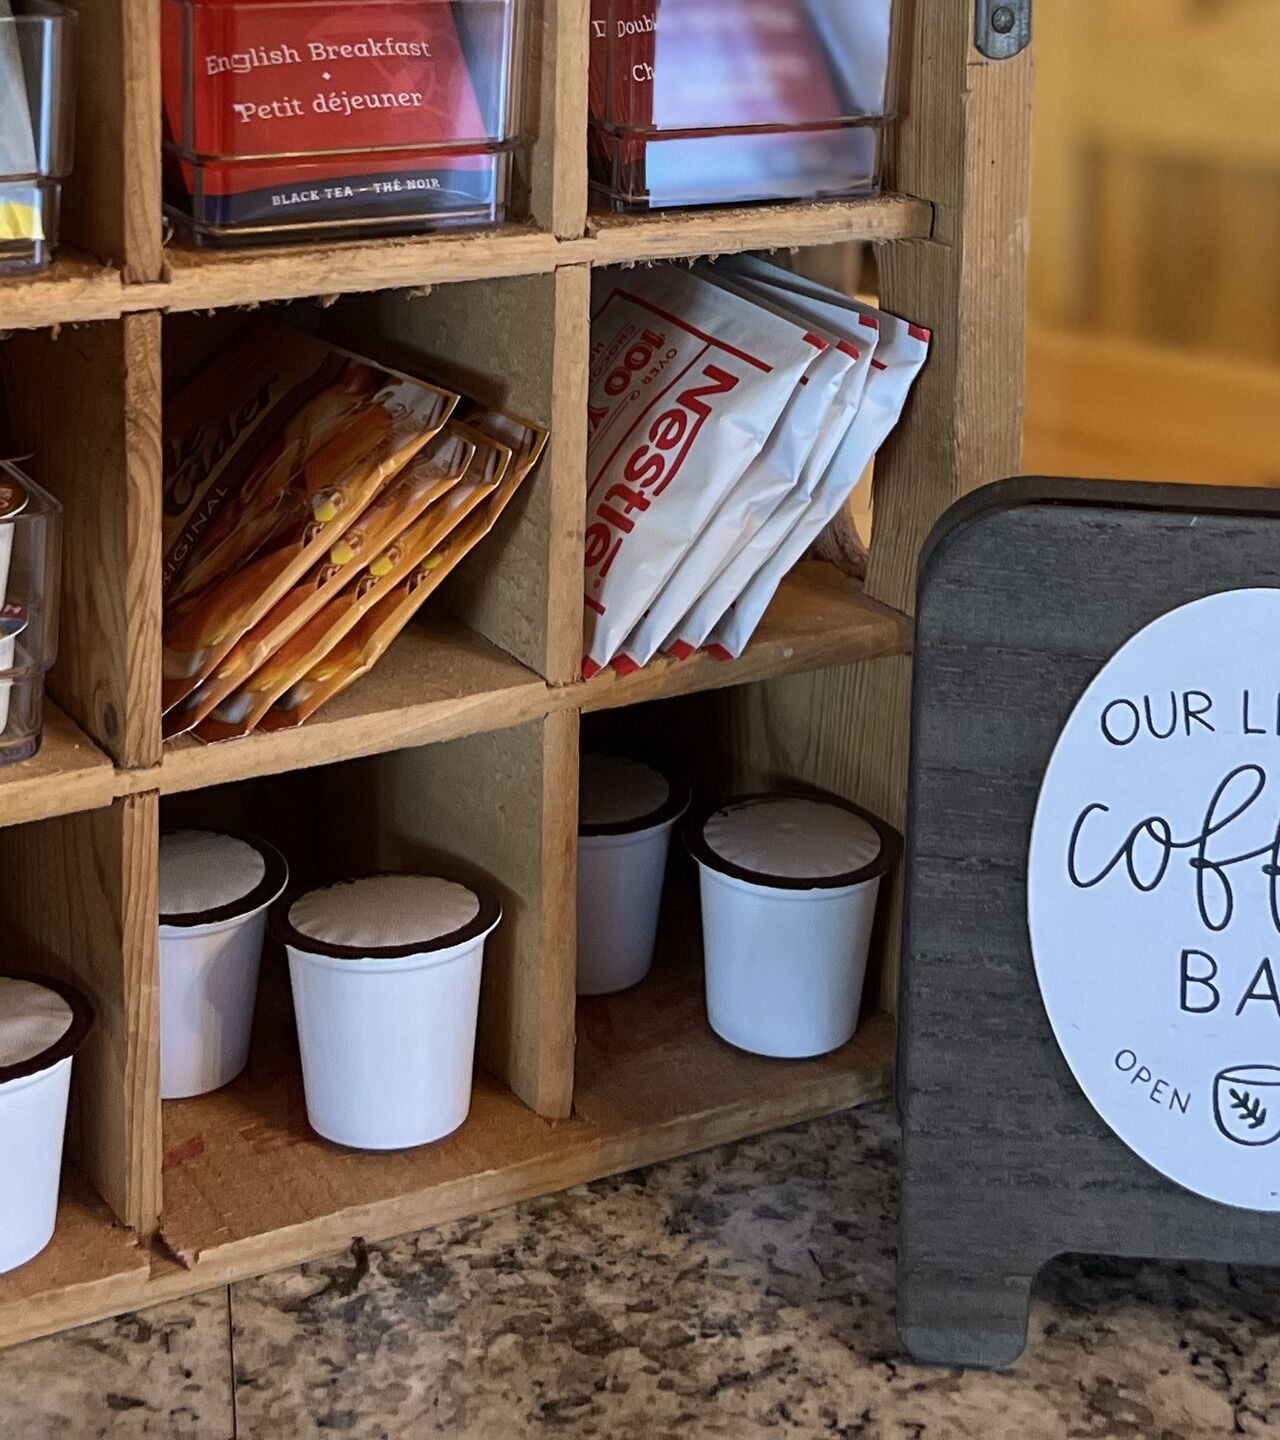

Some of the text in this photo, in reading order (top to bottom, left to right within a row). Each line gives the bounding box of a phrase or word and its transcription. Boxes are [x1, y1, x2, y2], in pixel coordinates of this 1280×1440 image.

[206, 37, 432, 76] English Breakfast
[233, 90, 423, 123] Petit déjeuner
[271, 177, 441, 207] BLACK TEA THÉ NOIR
[604, 329, 666, 396] 100
[163, 486, 229, 586] RIGINAL
[1101, 690, 1215, 746] OUR
[1114, 1048, 1193, 1116] OPEN
